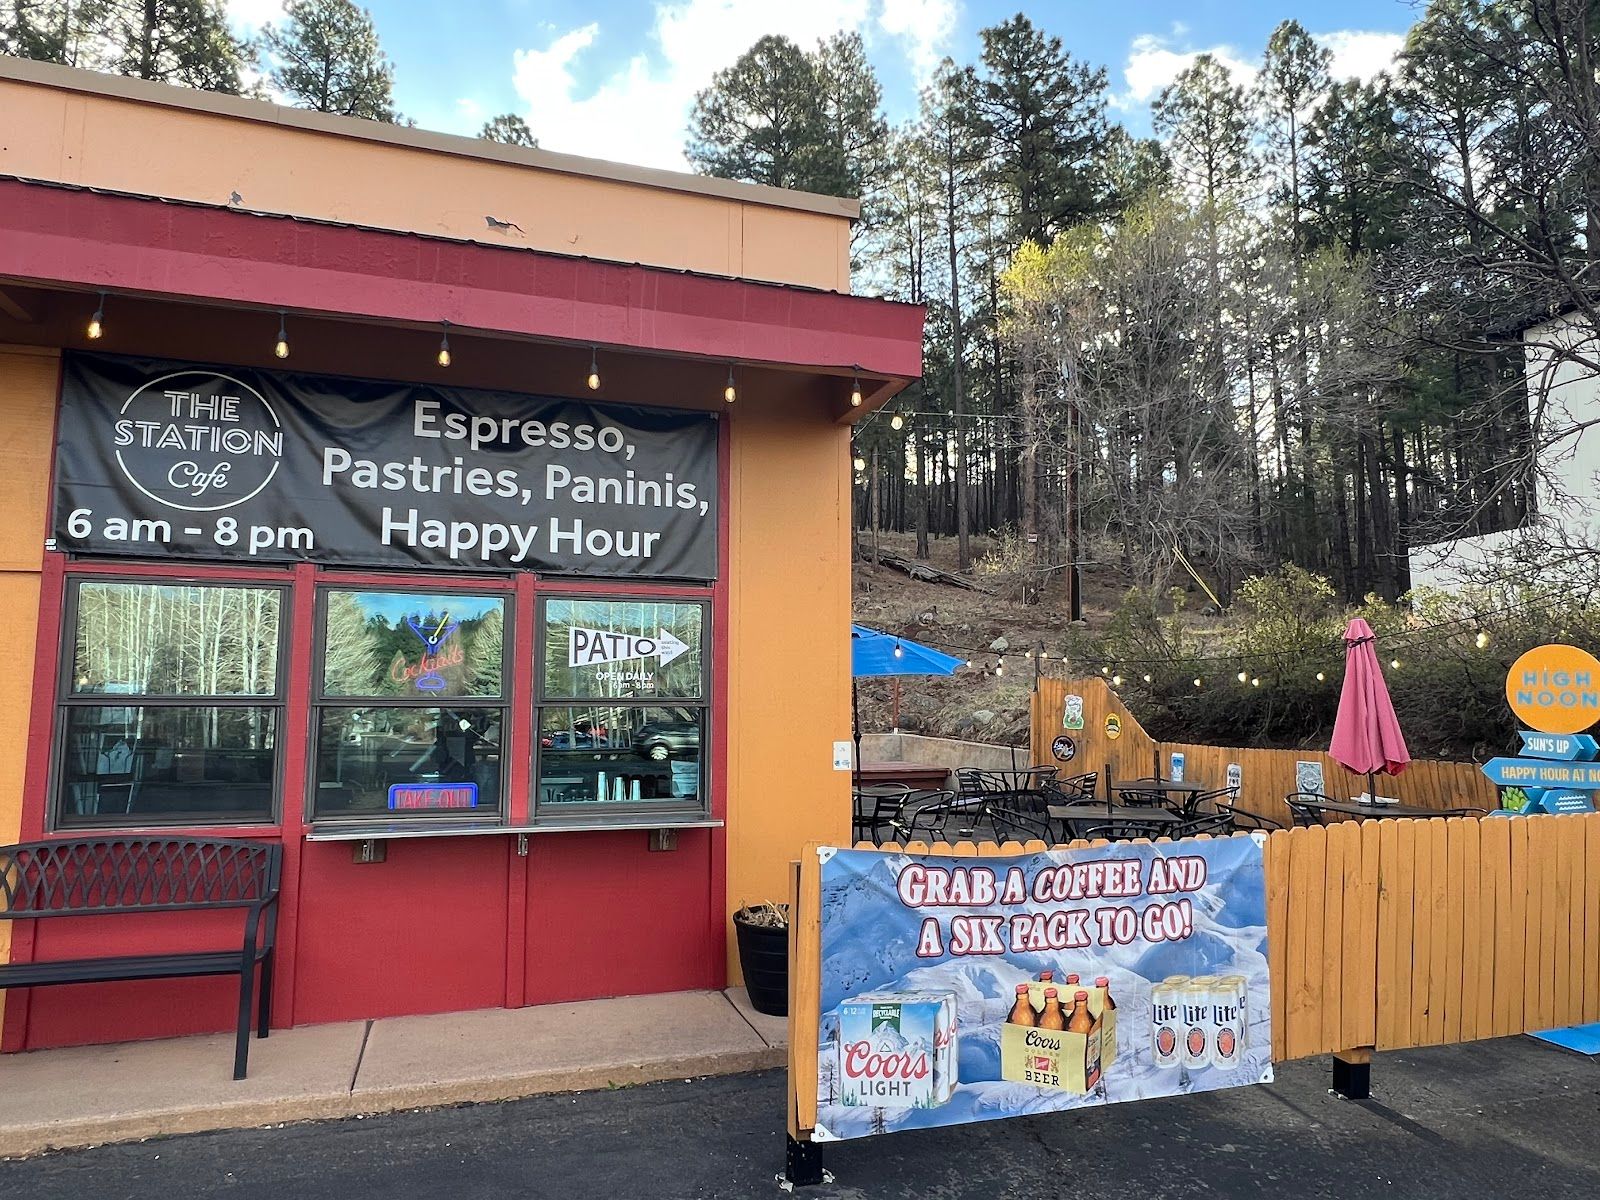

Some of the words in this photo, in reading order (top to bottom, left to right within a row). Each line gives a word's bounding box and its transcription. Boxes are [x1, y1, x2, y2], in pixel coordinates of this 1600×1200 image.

[164, 390, 241, 422] THE
[114, 419, 283, 457] STATION
[414, 400, 636, 461] Espresso,
[168, 461, 231, 496] Cafe
[322, 447, 532, 505] Pastries,
[546, 464, 710, 516] Paninis,
[67, 508, 93, 539] 6
[103, 517, 171, 543] am
[213, 516, 239, 546] 8
[249, 525, 314, 555] pm
[381, 507, 538, 563] Happy
[549, 517, 661, 558] Hour
[574, 629, 657, 664] PATIO
[391, 644, 464, 682] Cocktails
[595, 672, 624, 681] OPEN
[626, 672, 654, 681] DAILY
[1523, 671, 1591, 687] HIGH
[1517, 690, 1598, 709] NOON
[1527, 737, 1554, 752] SUN'S
[1556, 740, 1570, 754] UP
[1501, 766, 1536, 780] HAPPY
[1540, 767, 1569, 781] HOUR
[1573, 768, 1585, 782] AT
[397, 788, 433, 808] TAKE
[438, 788, 471, 808] OUT
[898, 863, 997, 907] GRAB
[1001, 867, 1027, 904] A
[1034, 859, 1141, 901] COFFEE
[1147, 857, 1208, 892] AND
[917, 918, 944, 957] A
[950, 915, 1004, 954] SIX
[1010, 910, 1090, 953] PACK
[1097, 906, 1138, 946] TO
[1142, 899, 1194, 942] GO!
[1152, 1004, 1177, 1026] Lite
[1183, 1004, 1207, 1027] Lite
[1213, 1004, 1237, 1027] Lite
[1025, 1030, 1060, 1051] Coors
[844, 1041, 929, 1080] Coors
[860, 1081, 911, 1096] LIGHT
[1025, 1070, 1060, 1087] BEER
